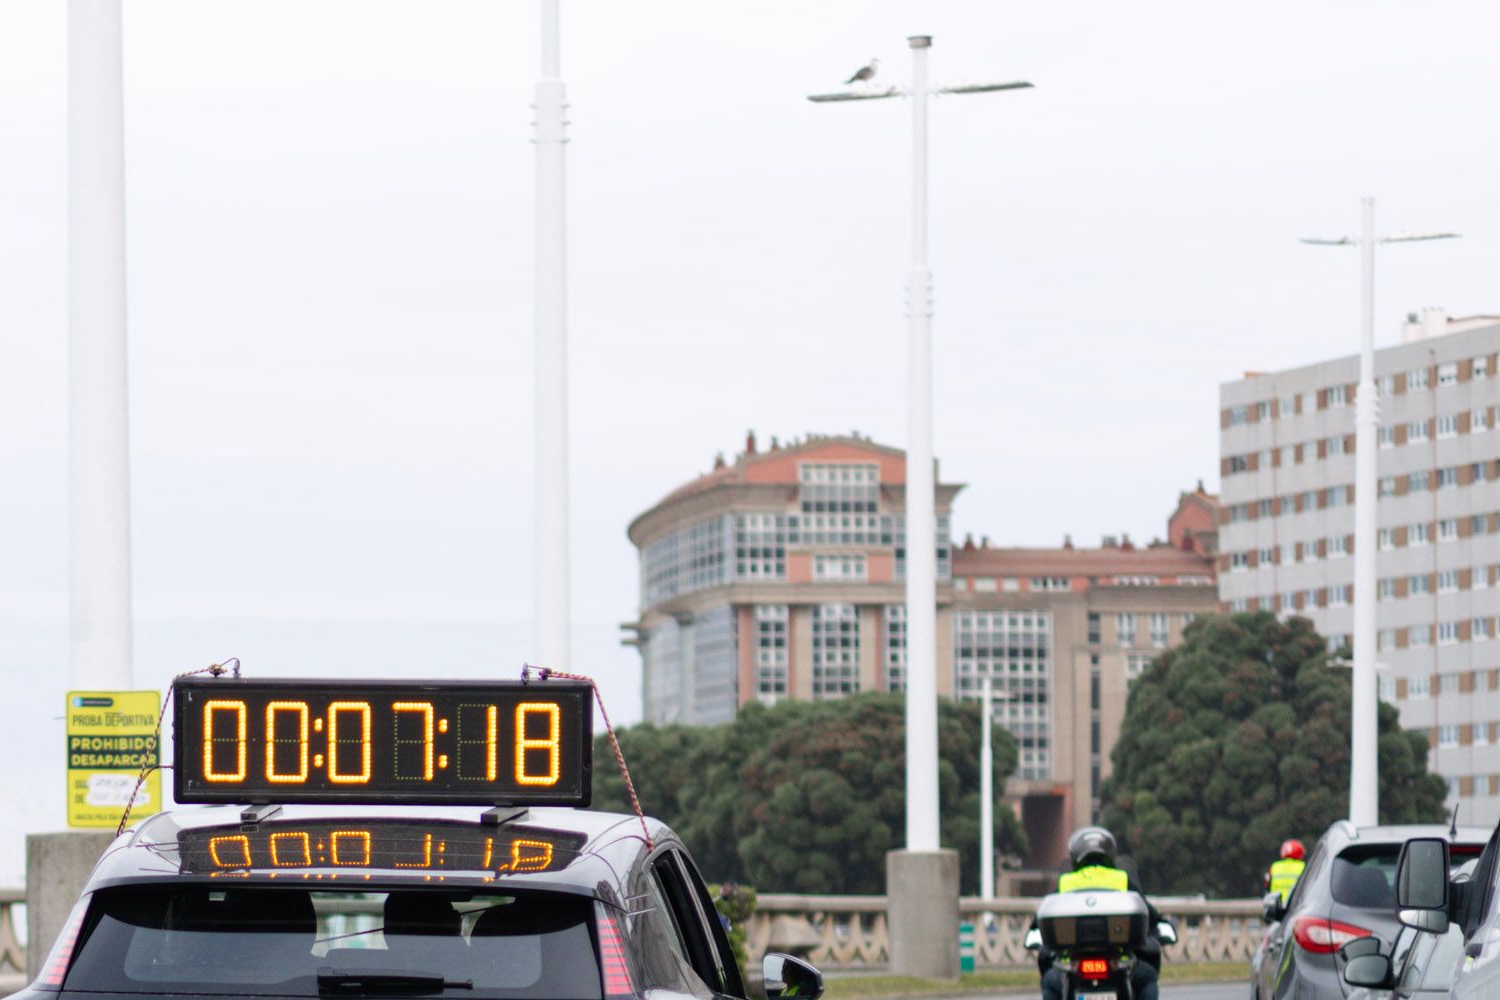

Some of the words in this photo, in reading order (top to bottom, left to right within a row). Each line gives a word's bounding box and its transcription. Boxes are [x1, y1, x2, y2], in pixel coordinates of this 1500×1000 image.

[71, 737, 157, 751] PROHIBIDO
[203, 700, 560, 785] 00:07:18
[71, 754, 157, 766] DESAPARCAR
